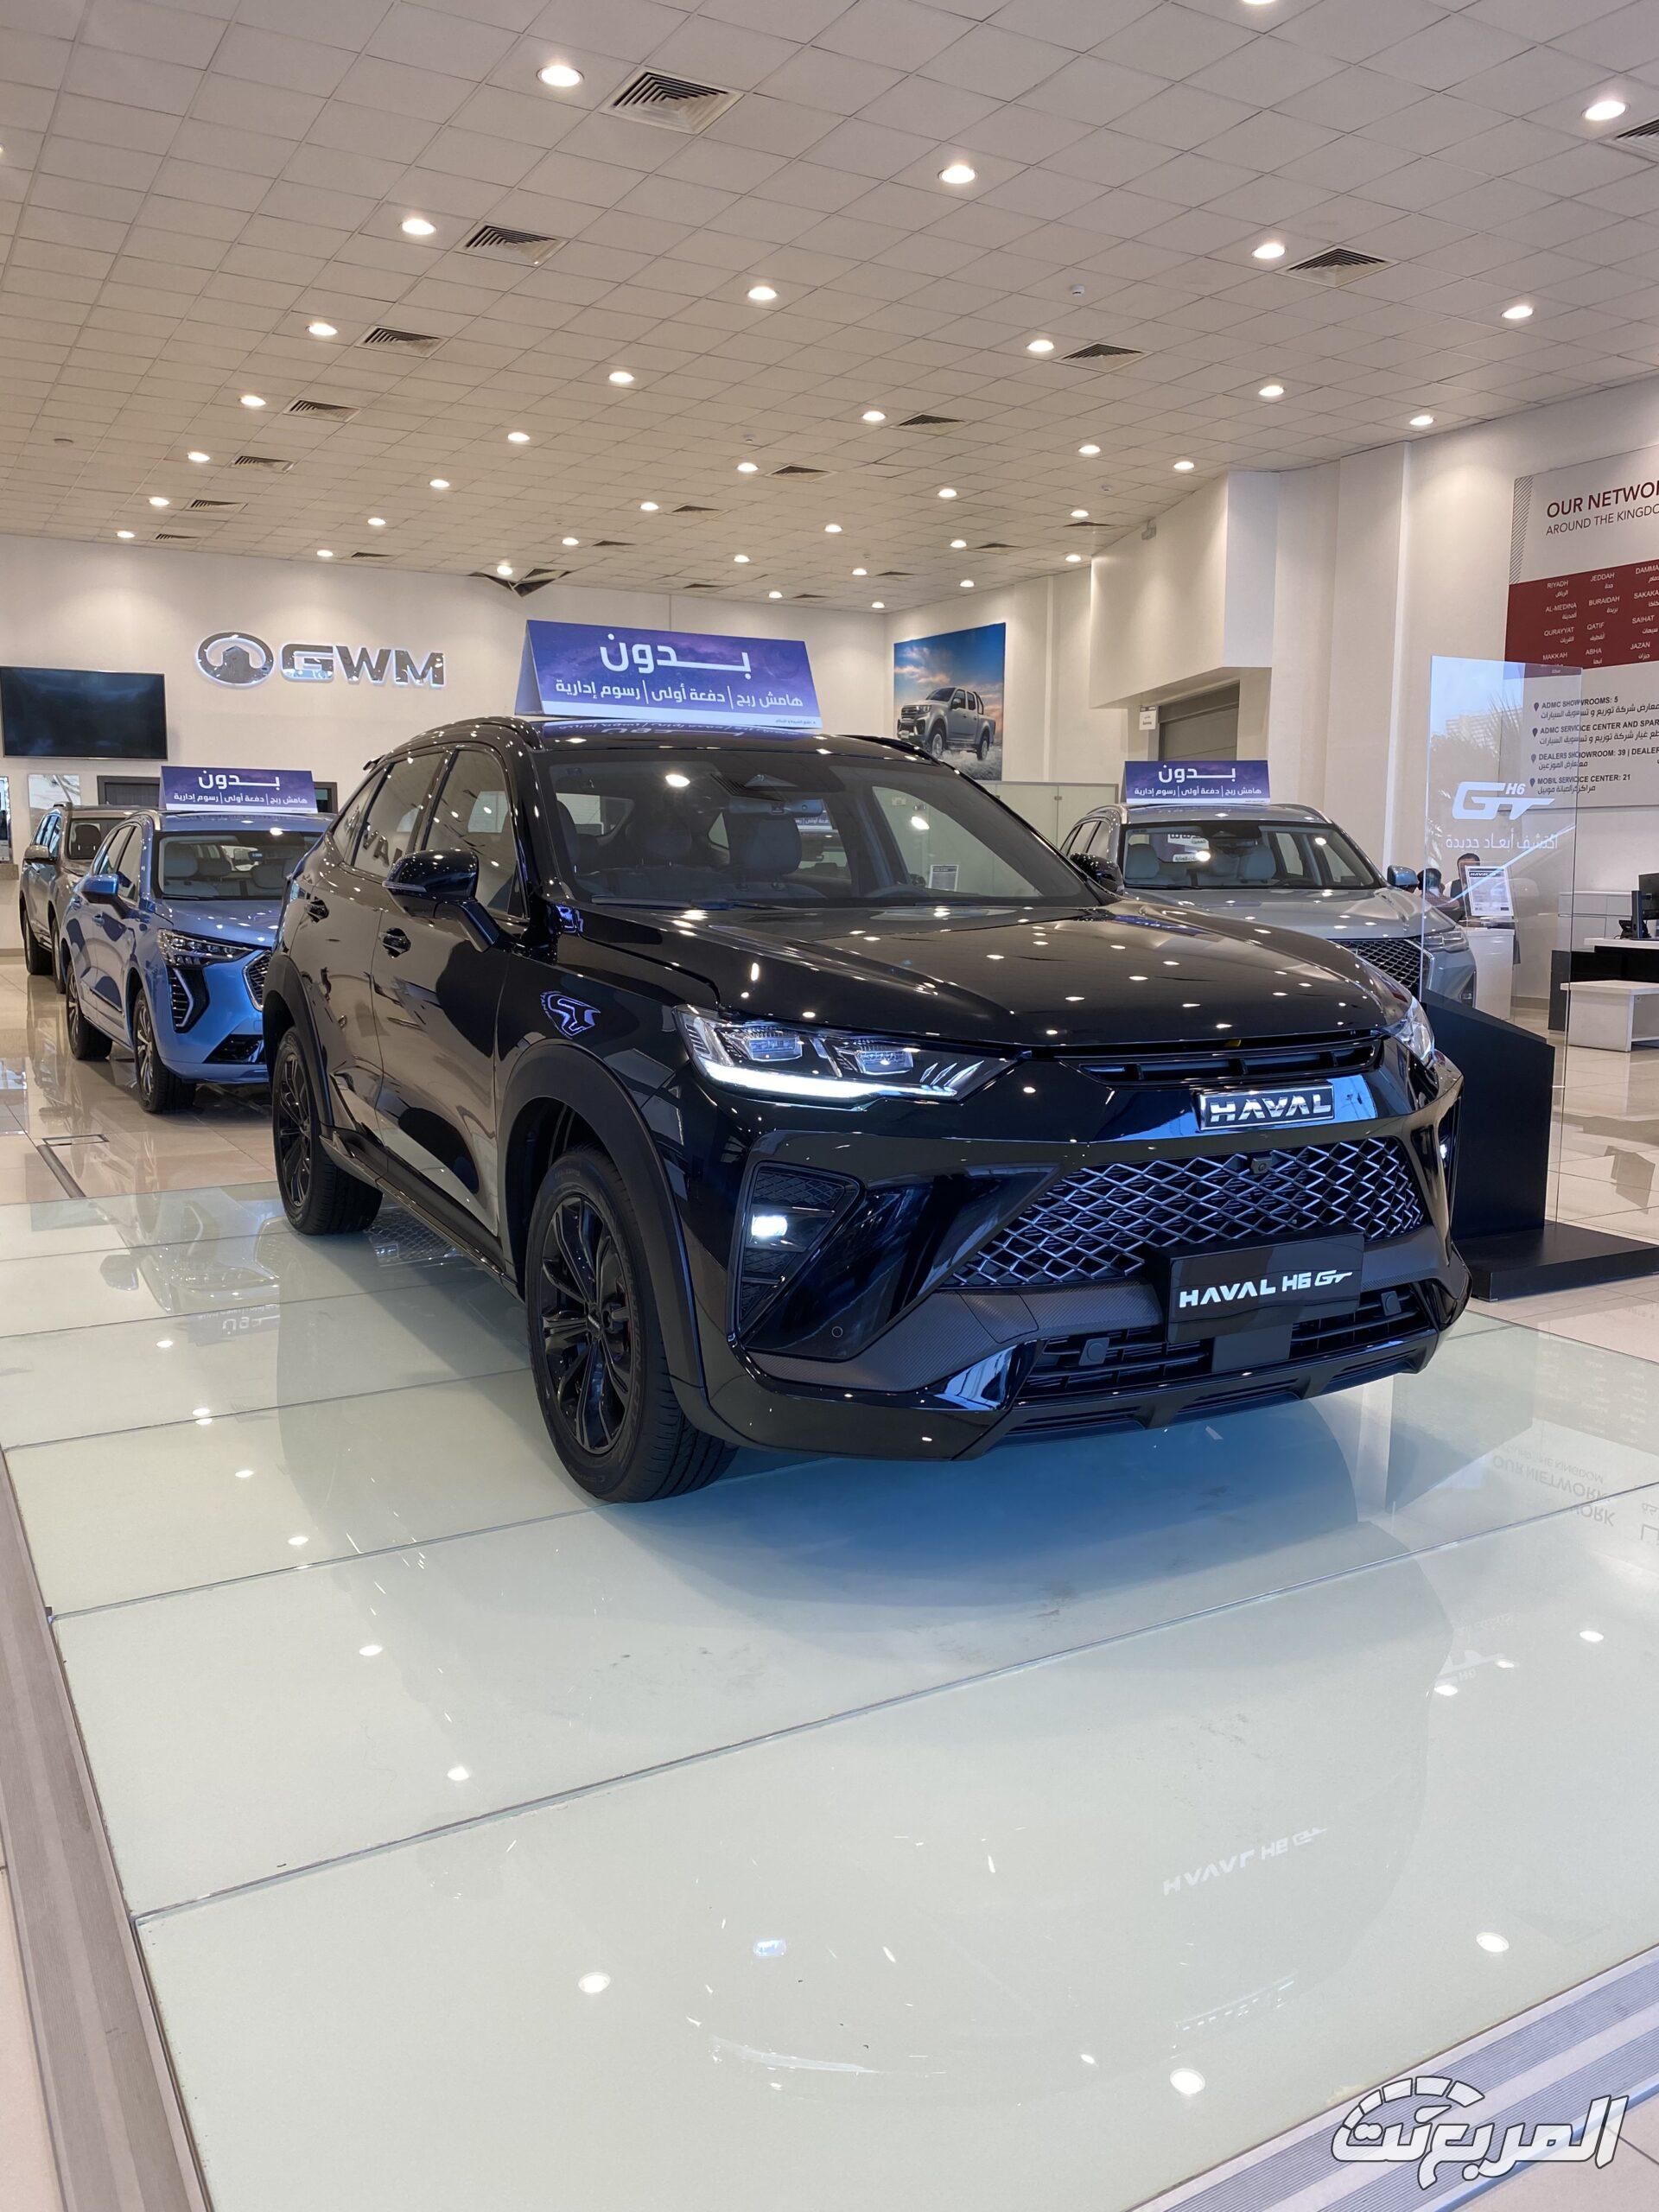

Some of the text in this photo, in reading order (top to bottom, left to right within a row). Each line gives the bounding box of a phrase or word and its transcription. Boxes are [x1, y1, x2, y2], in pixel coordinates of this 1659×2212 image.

[1547, 497, 1584, 518] OUR
[1545, 518, 1591, 536] AROUND
[1594, 512, 1615, 526] THE
[1590, 572, 1615, 582] JEDDAH
[1547, 580, 1569, 589] RIYADH
[1588, 595, 1621, 607] BURAIDAH
[1545, 601, 1578, 613] AL-MEDINA
[1631, 614, 1656, 624] SAIHAT
[1543, 626, 1575, 637] QURAYYAT
[1586, 621, 1605, 631] QATIF
[1630, 641, 1651, 650] JAZAN
[600, 633, 752, 680] بدون
[1542, 652, 1568, 661] MAKKAH
[1585, 647, 1602, 656] ABHA
[280, 643, 445, 688] GWM
[555, 678, 804, 709] هامش ربح دفعة أولى رسوم إدارية
[1541, 701, 1561, 709] ADMC
[1540, 726, 1560, 734] ADMC
[1592, 721, 1621, 731] CENTER
[1623, 721, 1638, 729] AND
[1538, 752, 1567, 761] DEALERS
[1158, 765, 1236, 784] بدون
[198, 770, 281, 791] بدون
[1200, 787, 1220, 796] دفعة
[1237, 786, 1262, 796] هامش
[1505, 783, 1527, 796] H6
[245, 794, 265, 803] دفعة
[283, 795, 308, 805] هامش
[1446, 834, 1480, 853] جديدة
[1210, 1093, 1332, 1123] HAVAL
[1179, 1278, 1276, 1308] HAVAL
[1281, 1272, 1312, 1292] H6
